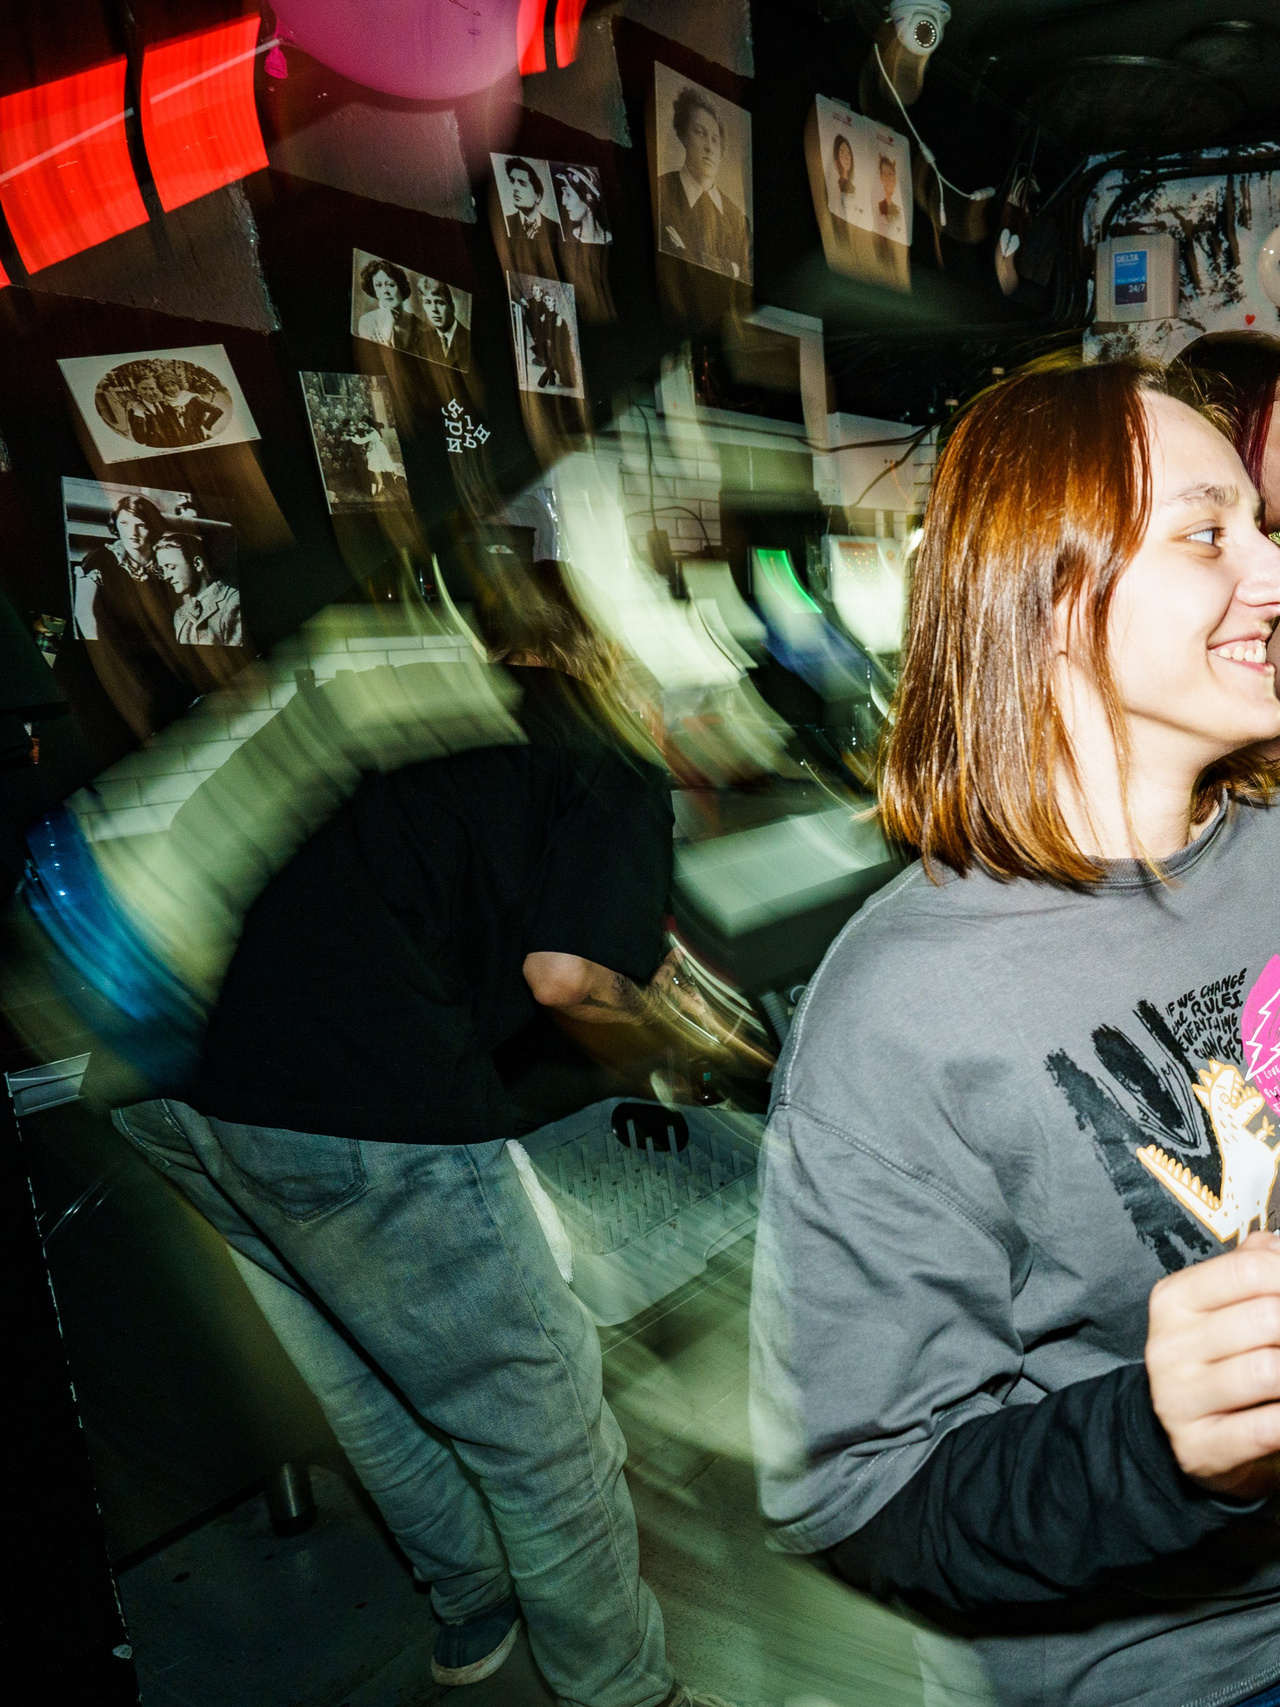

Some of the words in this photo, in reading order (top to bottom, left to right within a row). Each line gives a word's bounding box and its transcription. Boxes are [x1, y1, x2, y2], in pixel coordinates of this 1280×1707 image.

[1116, 253, 1139, 263] DELTA
[1177, 989, 1196, 1008] WE
[1200, 967, 1247, 999] CHANGE
